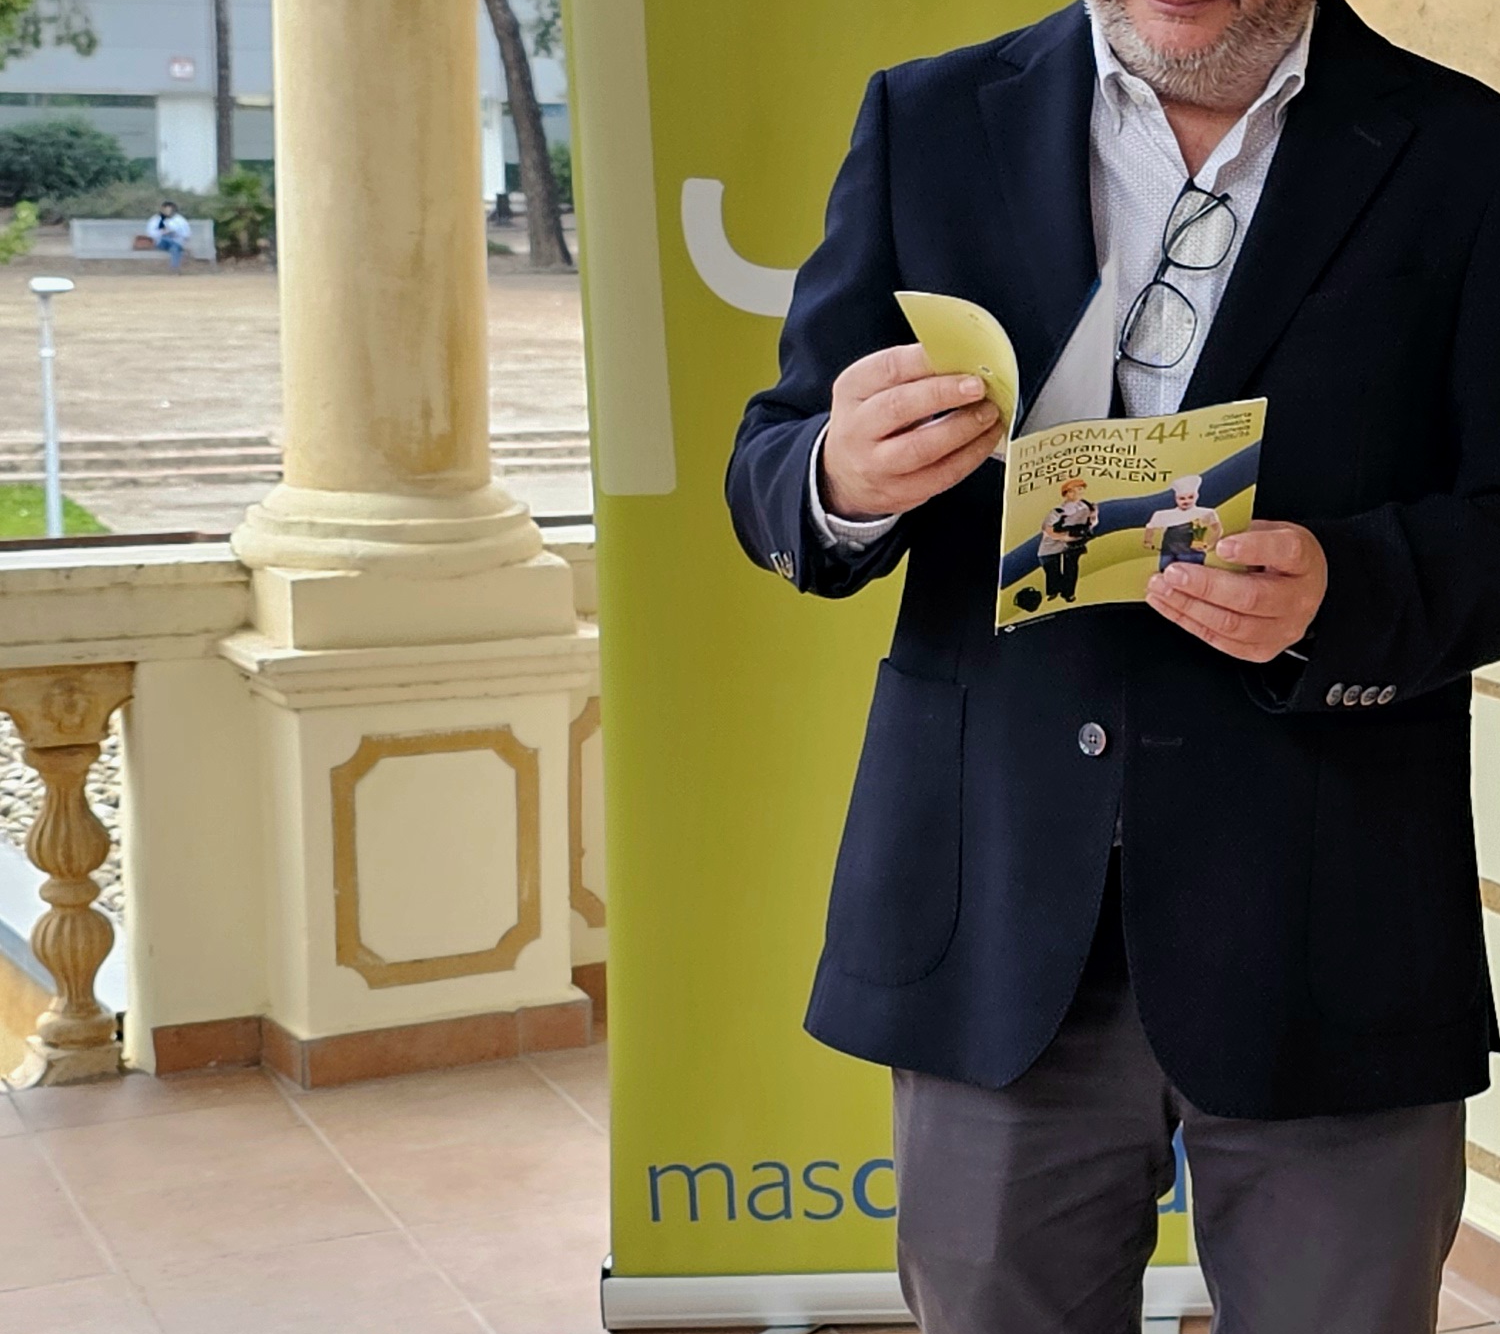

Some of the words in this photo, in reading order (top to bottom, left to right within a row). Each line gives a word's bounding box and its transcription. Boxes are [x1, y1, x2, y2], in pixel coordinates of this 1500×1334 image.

[1146, 419, 1189, 444] 44
[1018, 454, 1158, 484] DESCOBREIX
[1019, 443, 1137, 471] mascarandell
[1018, 481, 1041, 496] EL
[1045, 467, 1081, 485] TEU
[1086, 466, 1172, 483] TALENT
